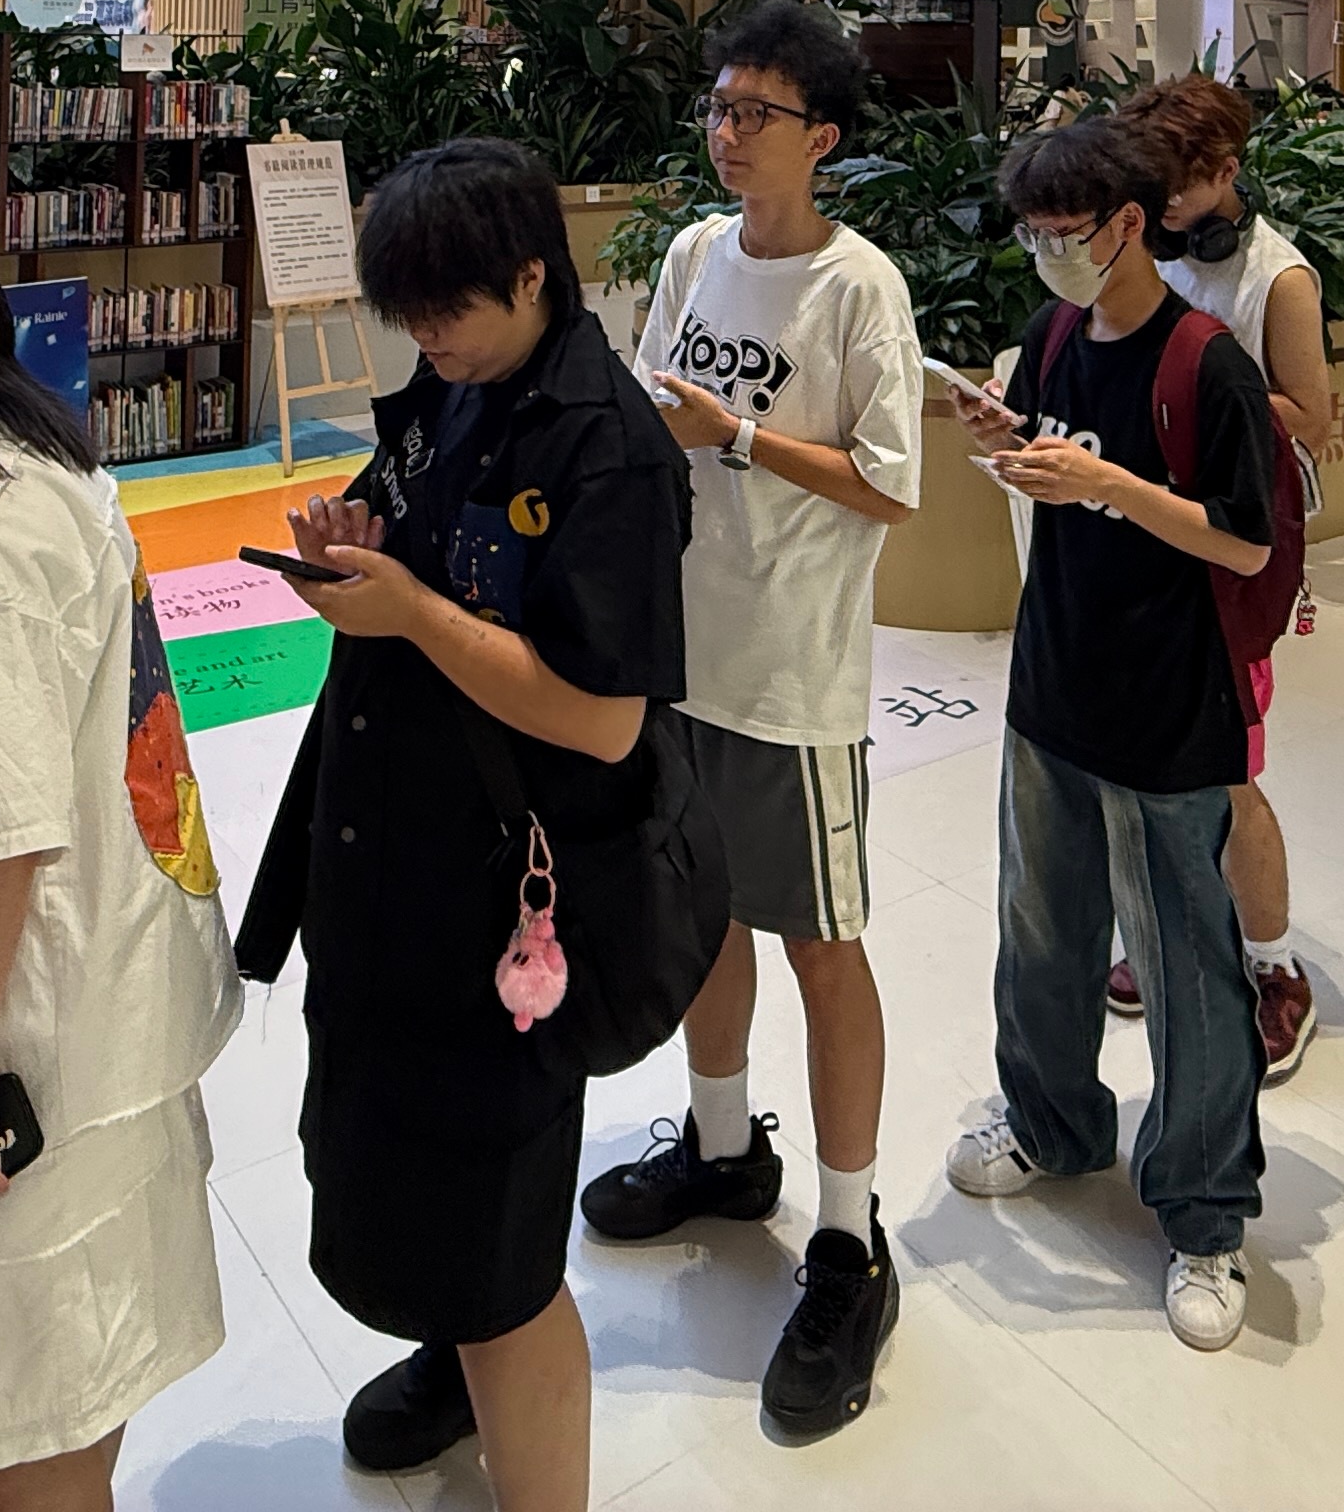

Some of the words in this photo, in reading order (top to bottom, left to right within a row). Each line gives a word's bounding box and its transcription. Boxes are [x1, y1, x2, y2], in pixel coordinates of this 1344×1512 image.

[196, 577, 271, 599] books
[158, 598, 242, 621] 读物
[196, 655, 245, 673] and
[252, 651, 289, 666] art
[175, 673, 264, 696] 艺术
